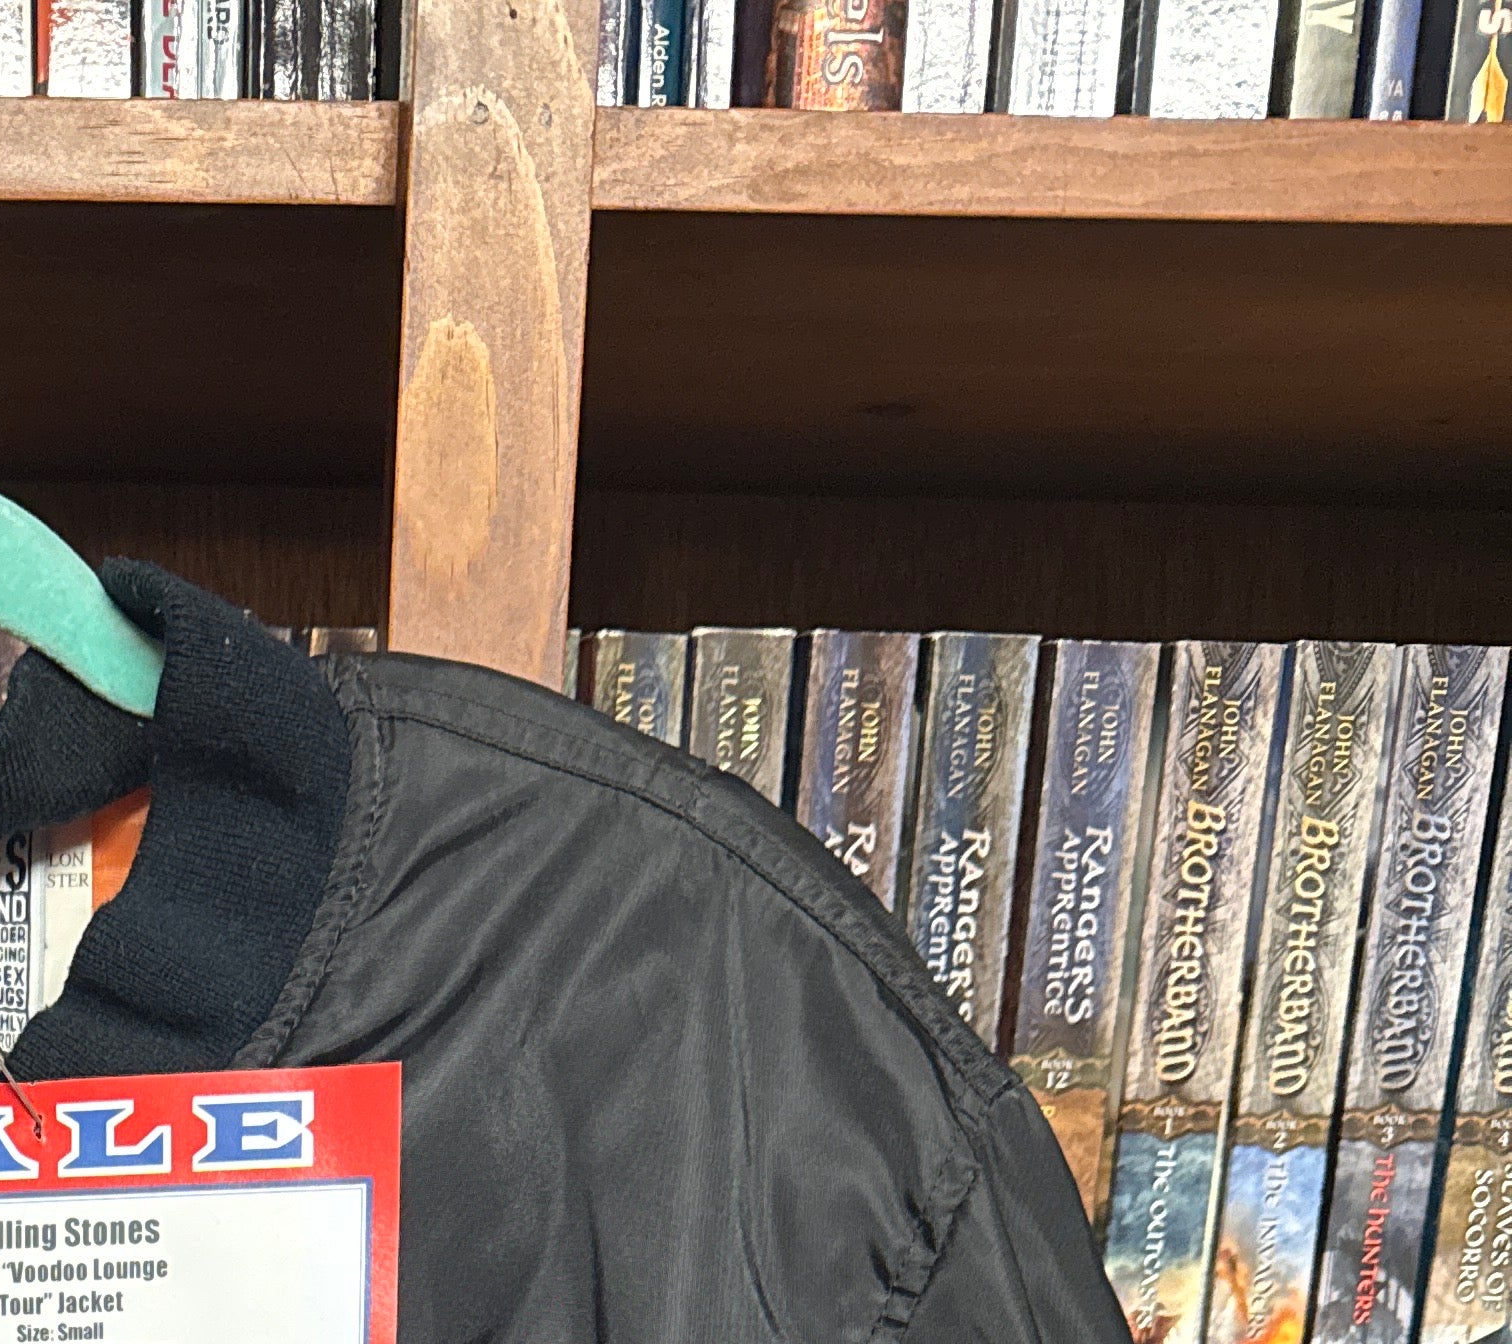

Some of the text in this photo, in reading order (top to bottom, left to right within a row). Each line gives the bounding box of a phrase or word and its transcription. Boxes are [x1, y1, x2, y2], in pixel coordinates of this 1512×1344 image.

[831, 669, 860, 794] FLANAGAN
[857, 701, 881, 764] JOHN
[946, 673, 975, 799] FLANAGAN
[974, 705, 997, 768] JOHN
[1070, 671, 1101, 796] FLANAGAN
[1097, 704, 1121, 765] JOHN
[1191, 665, 1223, 792] FLANAGAN
[1218, 698, 1243, 761] JOHN
[1305, 681, 1337, 807] FLANAGAN
[1332, 714, 1355, 776] JOHN
[1416, 676, 1449, 800] FLANAGAN
[1445, 709, 1470, 769] JOHN
[1155, 798, 1227, 1083] BROTHERBAND
[1268, 815, 1340, 1097] BROTHERBAND
[1379, 809, 1452, 1092] BROTHERBAND
[1045, 1070, 1071, 1090] 12
[1164, 1116, 1173, 1136] 1
[1273, 1132, 1286, 1150] 2
[1381, 1126, 1395, 1144] 3
[64, 1217, 161, 1248] Stones
[93, 1257, 168, 1282] Lounge
[16, 1321, 105, 1343] Size: Small
[57, 1290, 124, 1315] Jacket
